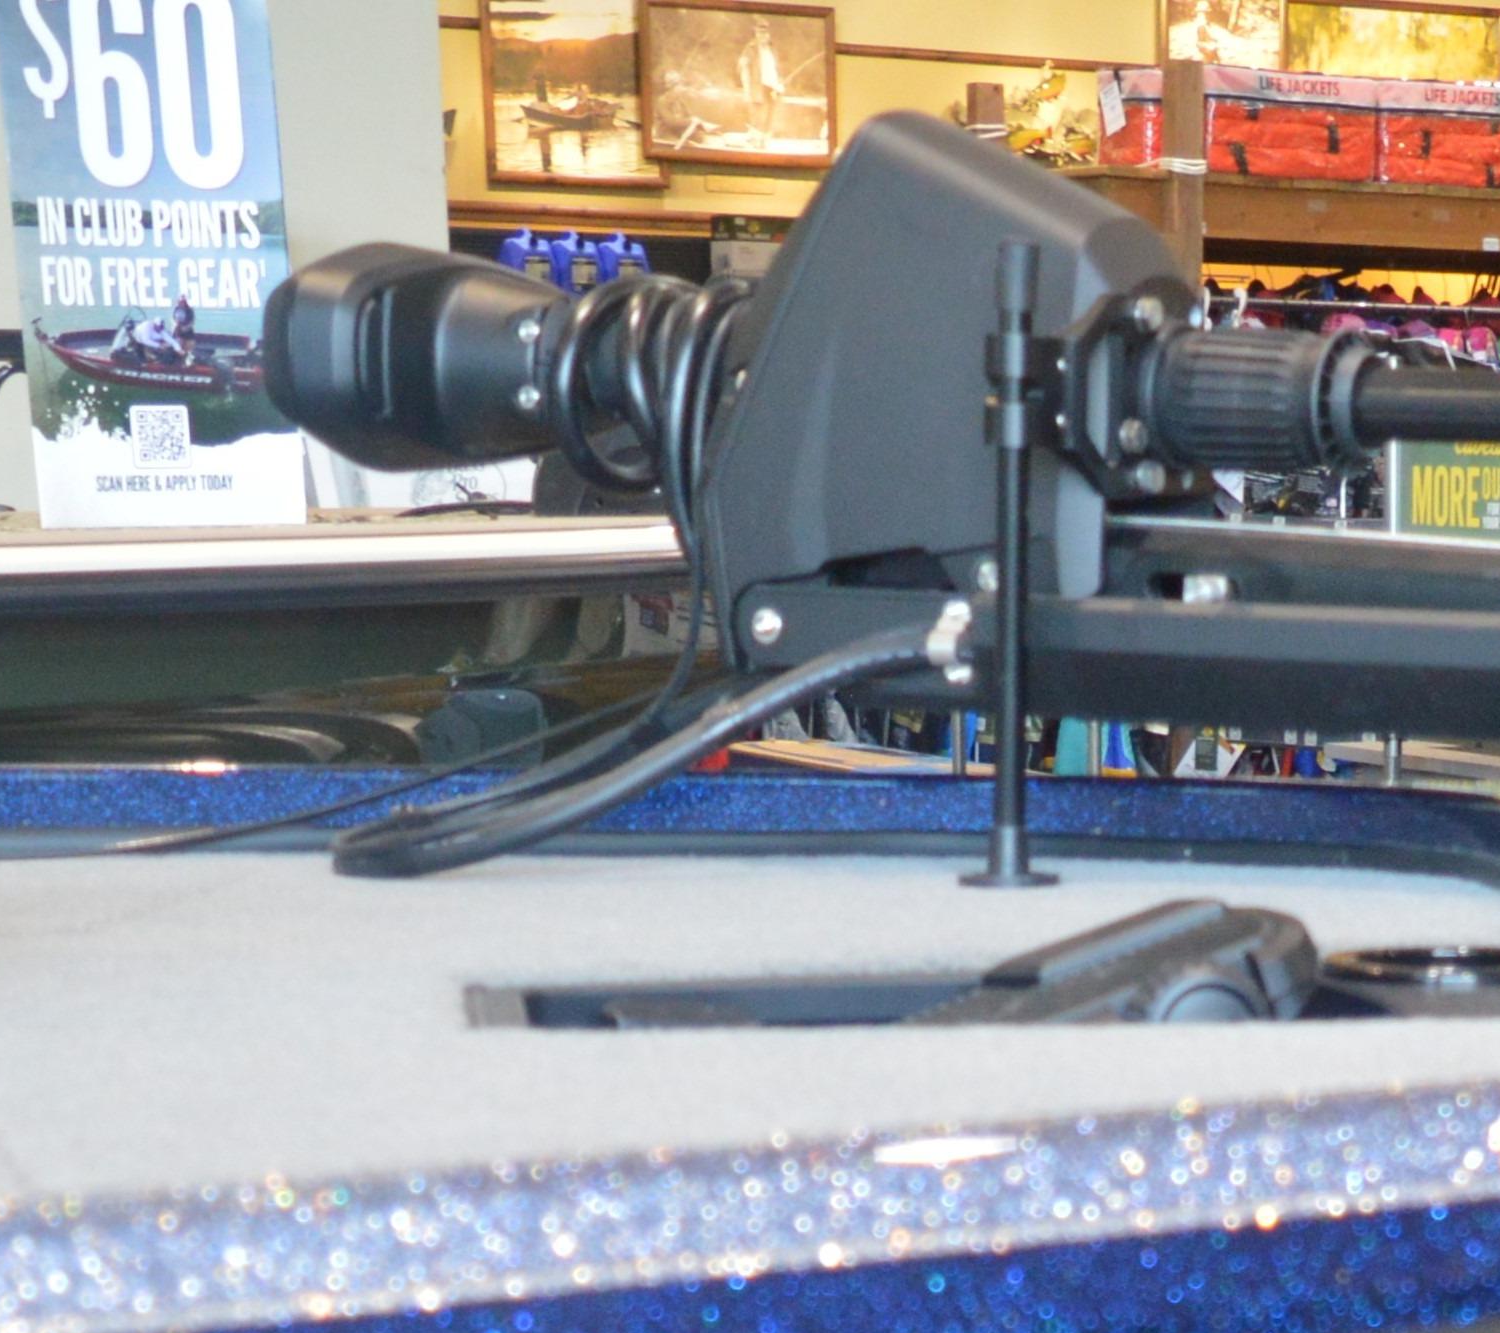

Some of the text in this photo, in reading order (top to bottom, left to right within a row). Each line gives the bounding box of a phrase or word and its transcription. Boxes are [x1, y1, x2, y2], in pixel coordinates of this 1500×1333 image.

[19, 0, 245, 189] $60
[1259, 76, 1340, 97] LIFE JACKETS
[1424, 88, 1500, 107] LIFE JACKETS
[37, 197, 261, 249] IN CLUB POINTS
[40, 256, 94, 306] FOR
[101, 257, 172, 308] FREE
[96, 475, 233, 492] SCAN HERE & APPLY TODAY
[1412, 465, 1480, 528] MORE
